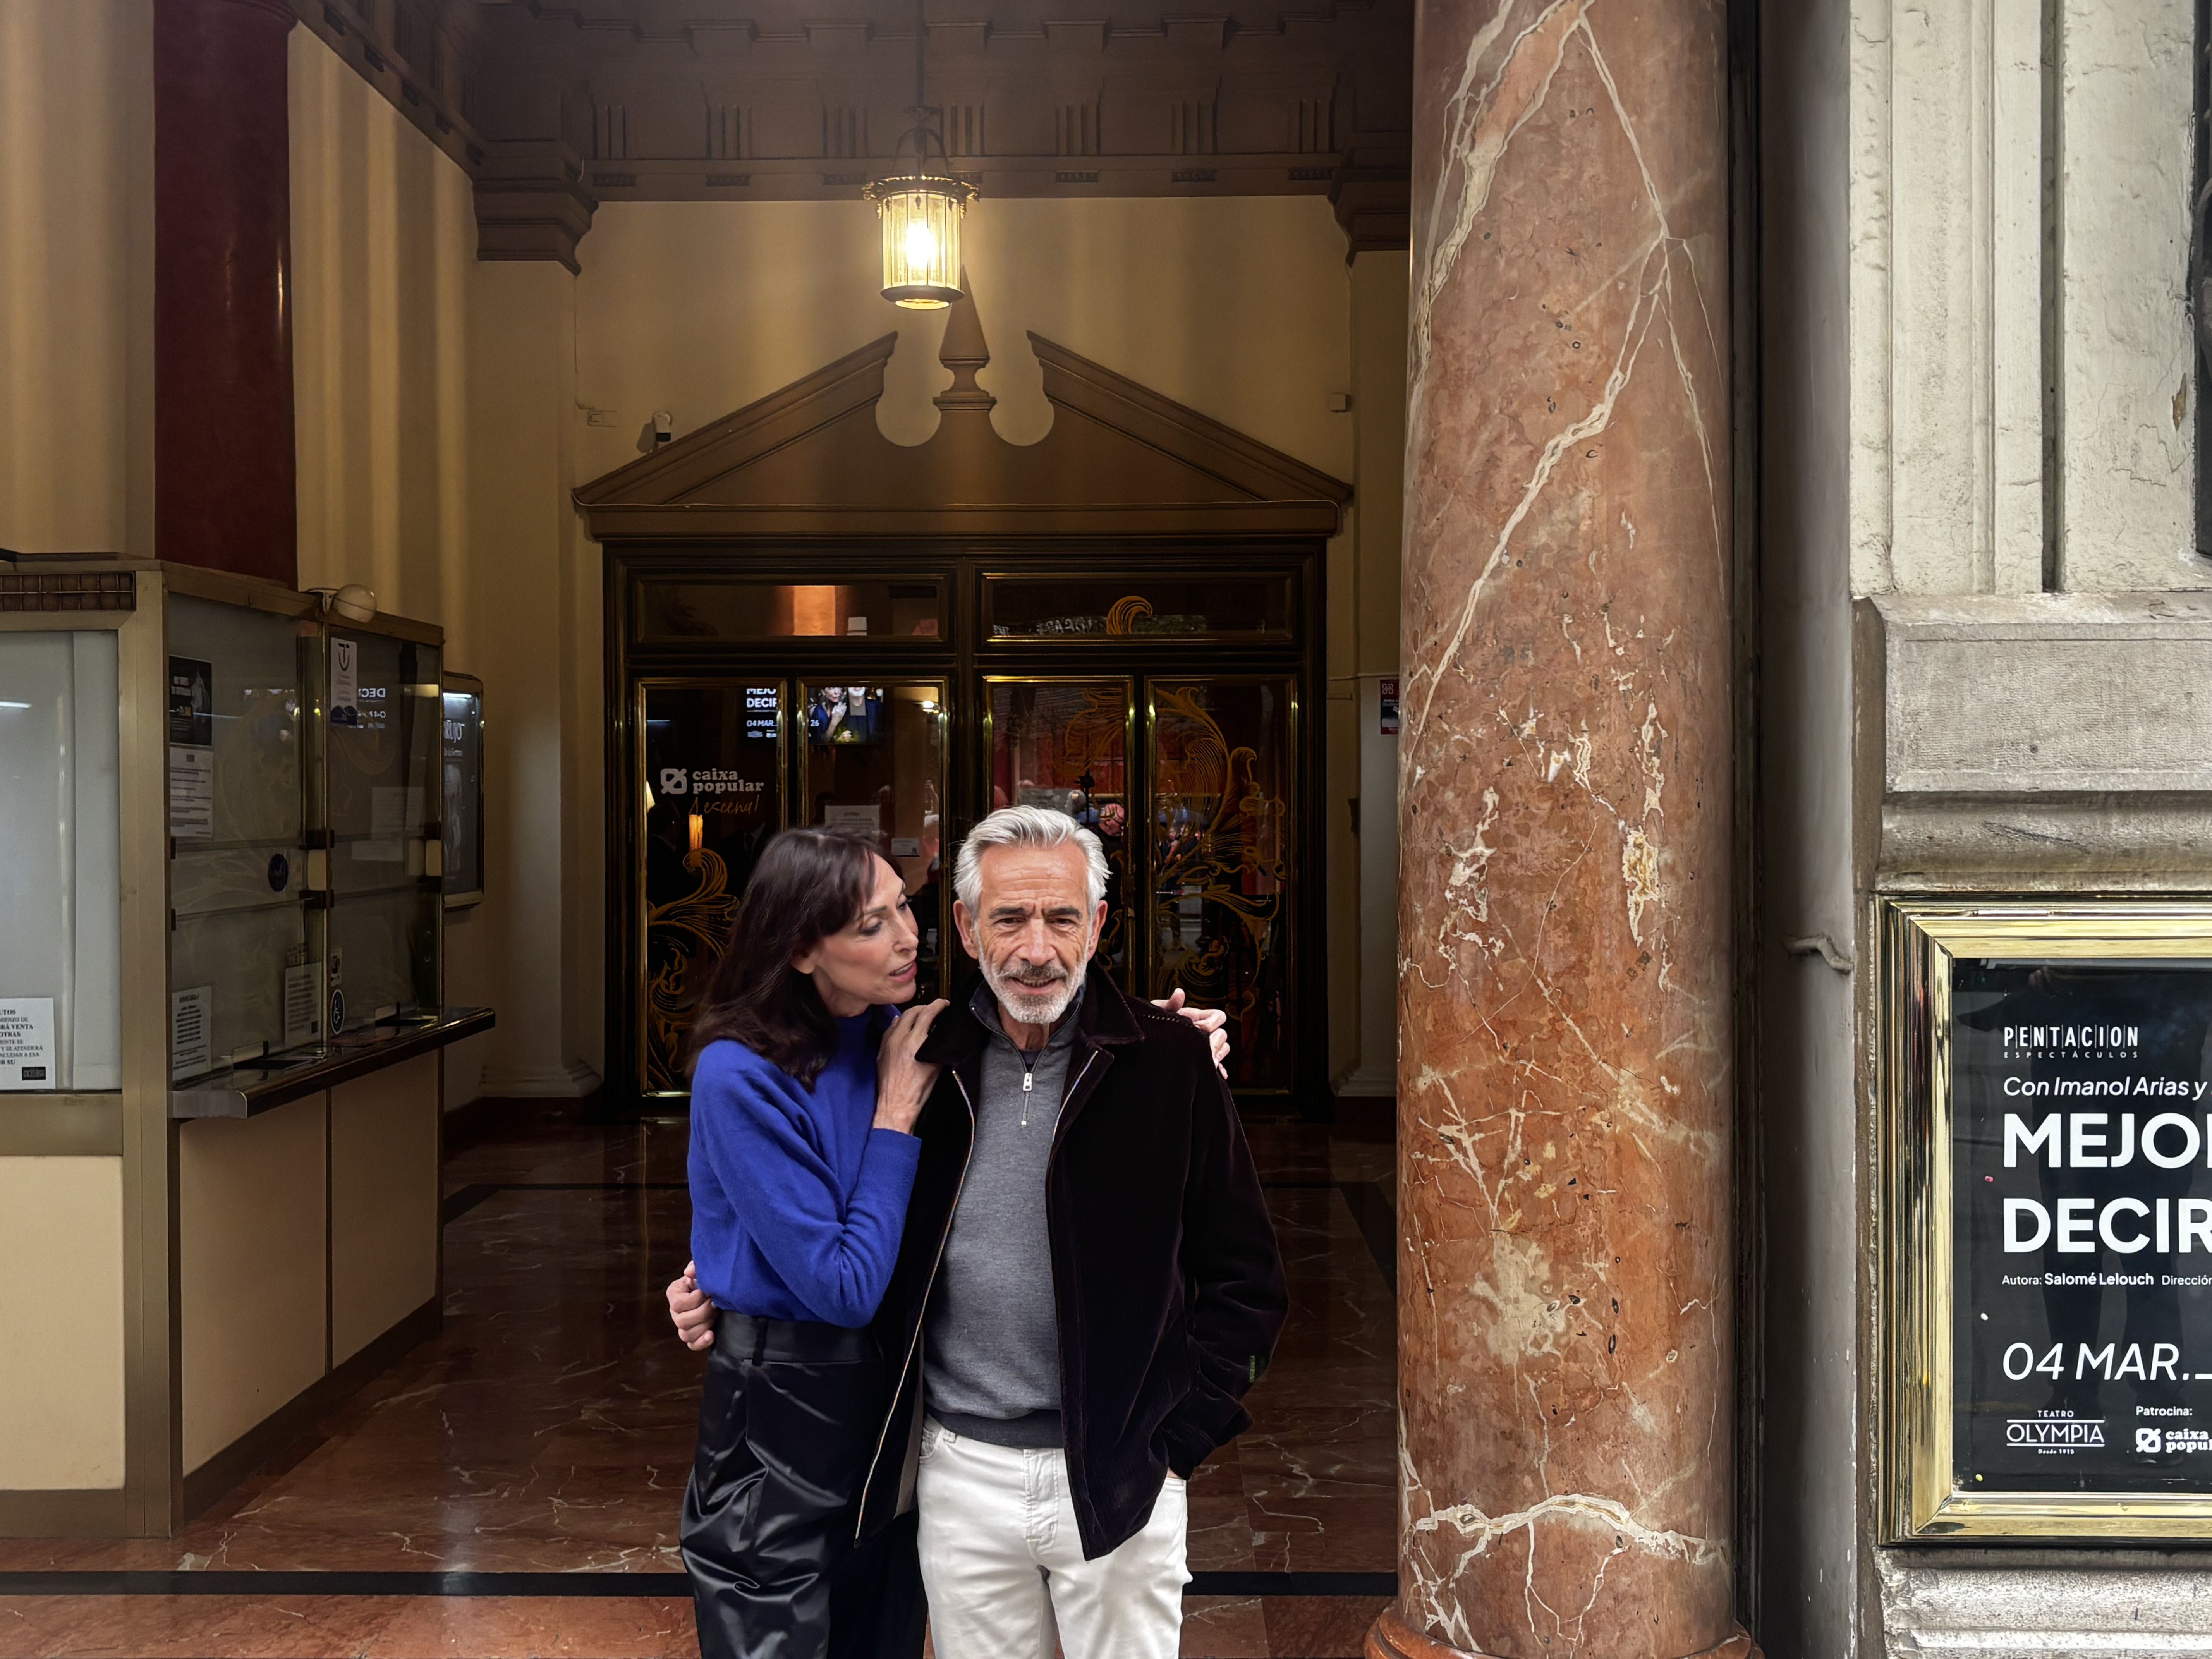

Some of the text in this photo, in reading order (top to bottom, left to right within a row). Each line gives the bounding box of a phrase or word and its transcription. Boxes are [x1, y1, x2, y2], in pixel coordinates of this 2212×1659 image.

[692, 768, 738, 780] caixa
[692, 779, 764, 794] popular
[2004, 1026, 2138, 1047] PENTACION
[2004, 1076, 2208, 1101] Con Imanol Arias y
[2004, 1112, 2212, 1169] MEJO
[2004, 1197, 2212, 1254] DECIR
[2002, 1275, 2042, 1285] Autora:
[2044, 1271, 2097, 1285] Salomé
[2099, 1273, 2154, 1285] Lelouch
[2003, 1342, 2064, 1380] 04
[2136, 1406, 2193, 1416] Patrocina:
[2006, 1424, 2104, 1443] OLYMPIA
[2165, 1428, 2209, 1440] caixa
